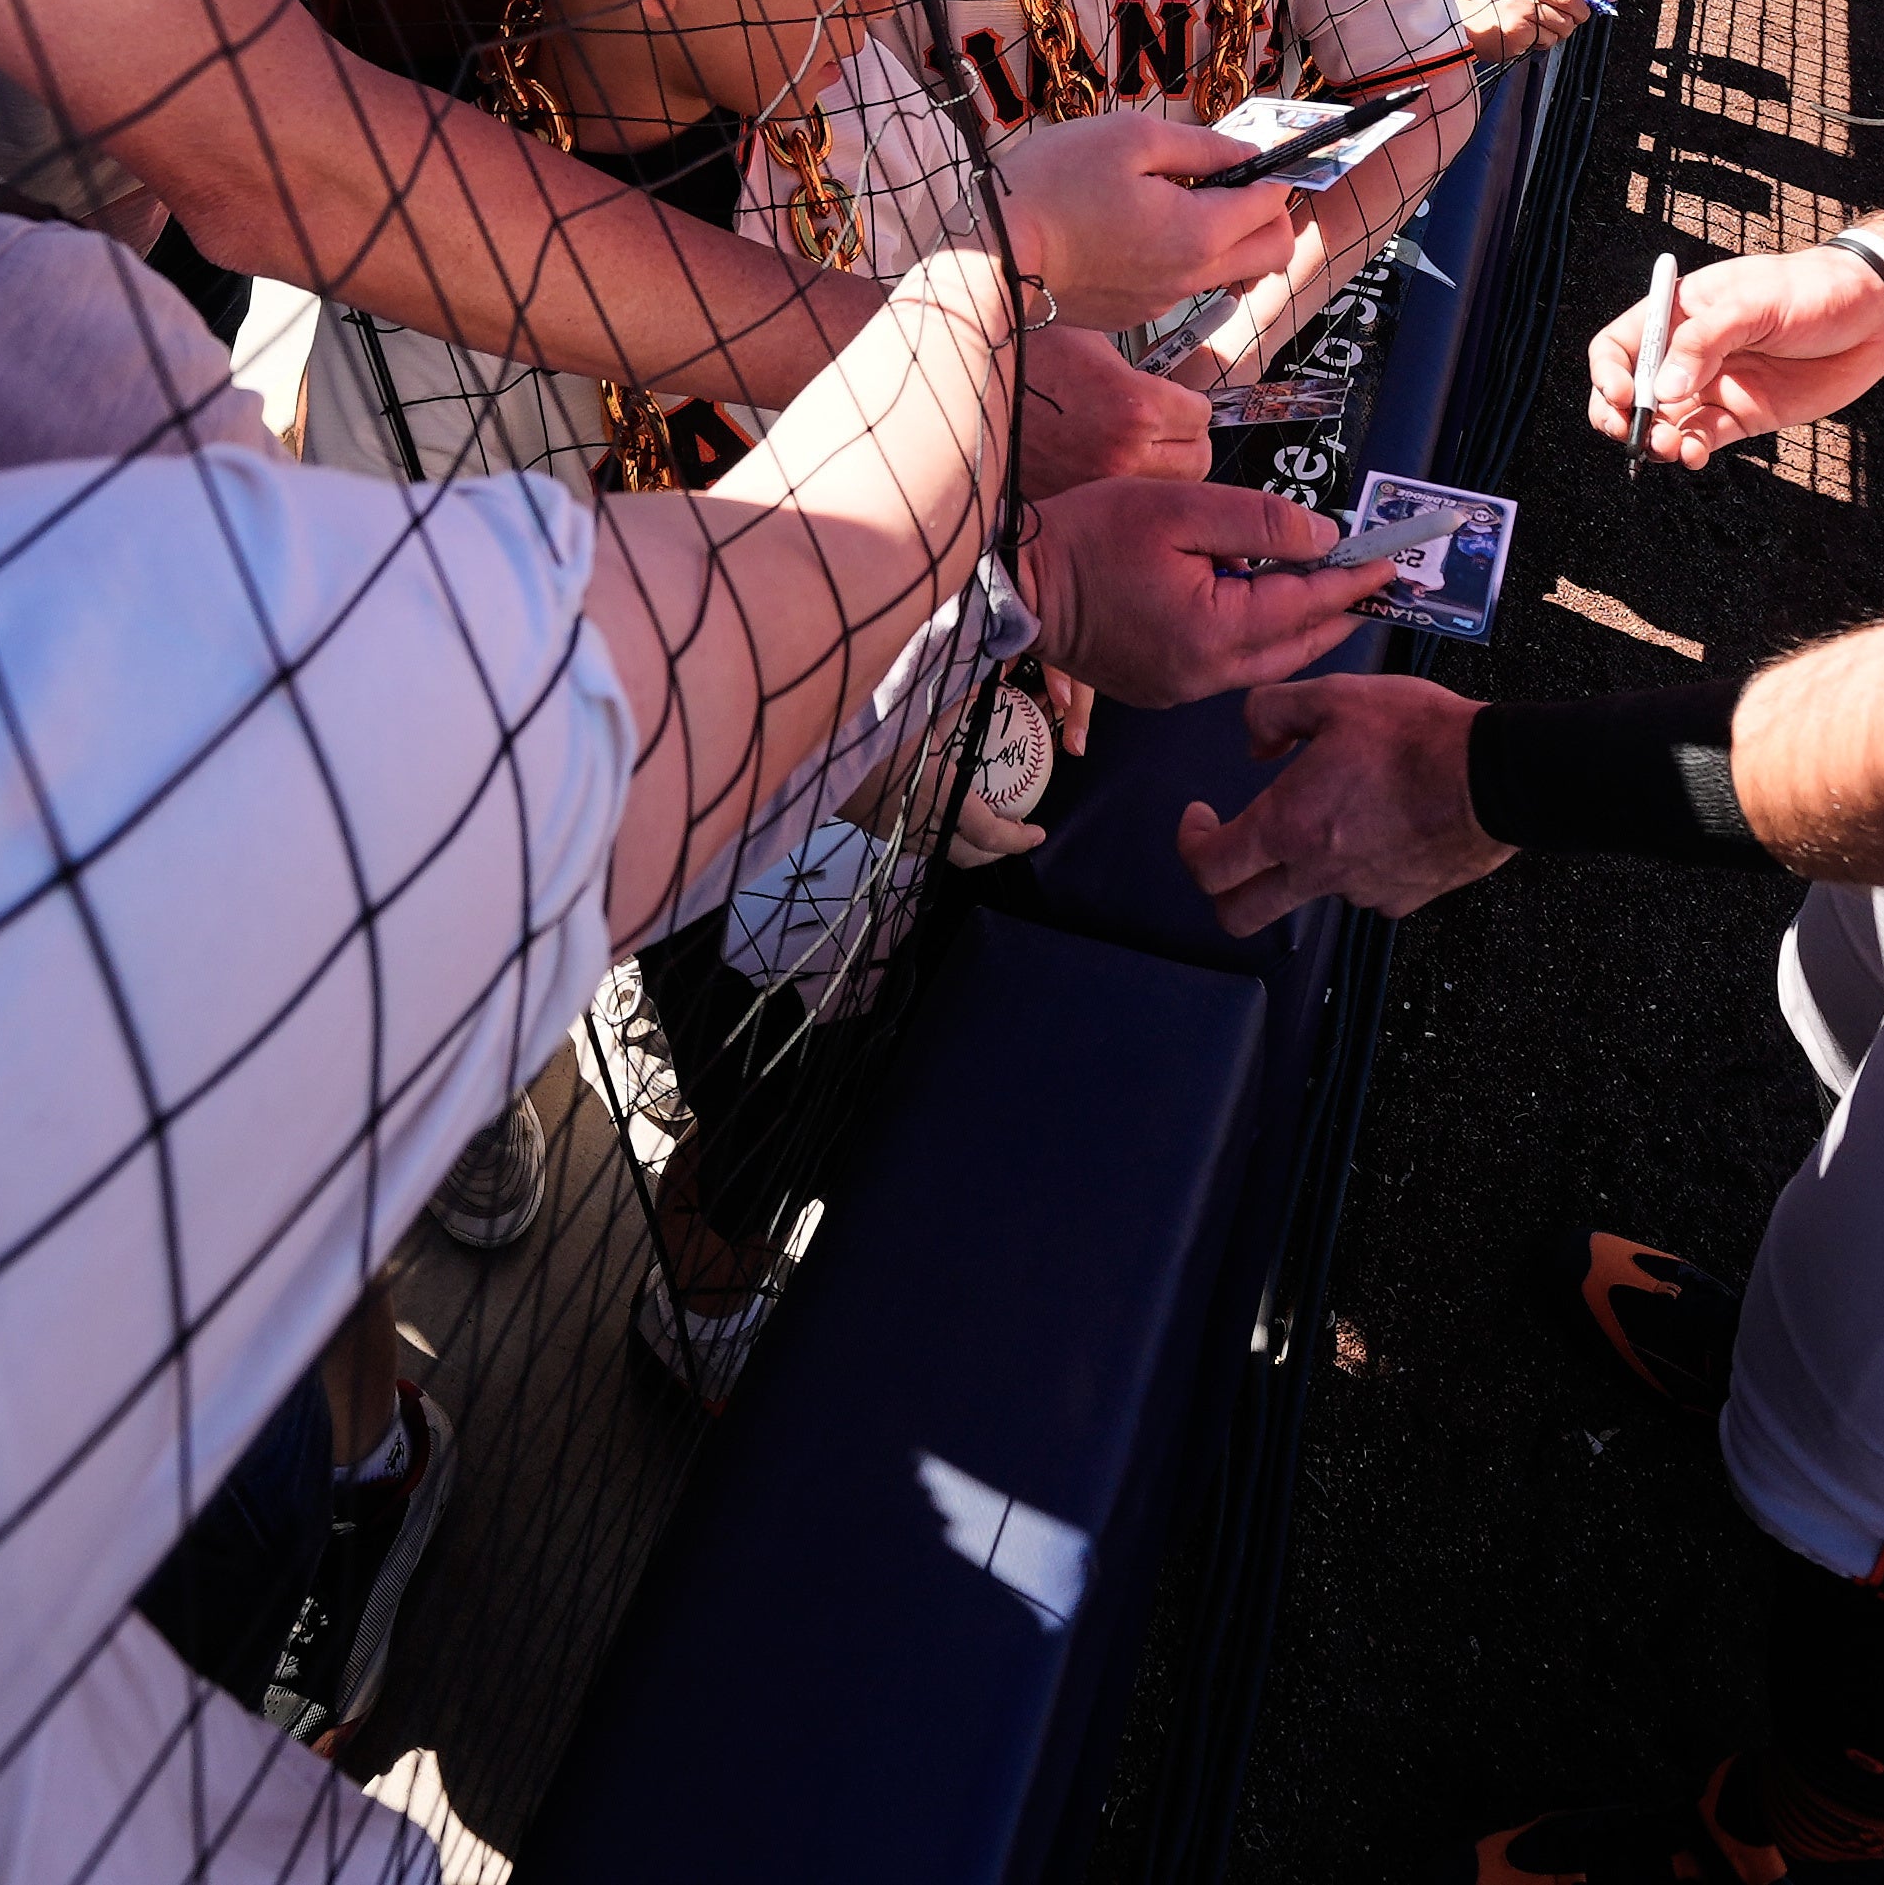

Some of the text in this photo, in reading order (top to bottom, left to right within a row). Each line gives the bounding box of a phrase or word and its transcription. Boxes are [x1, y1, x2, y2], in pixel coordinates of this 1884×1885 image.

[1396, 489, 1458, 507] ELDRIDGE
[1393, 548, 1427, 569] 23
[1359, 602, 1434, 625] GIANT
